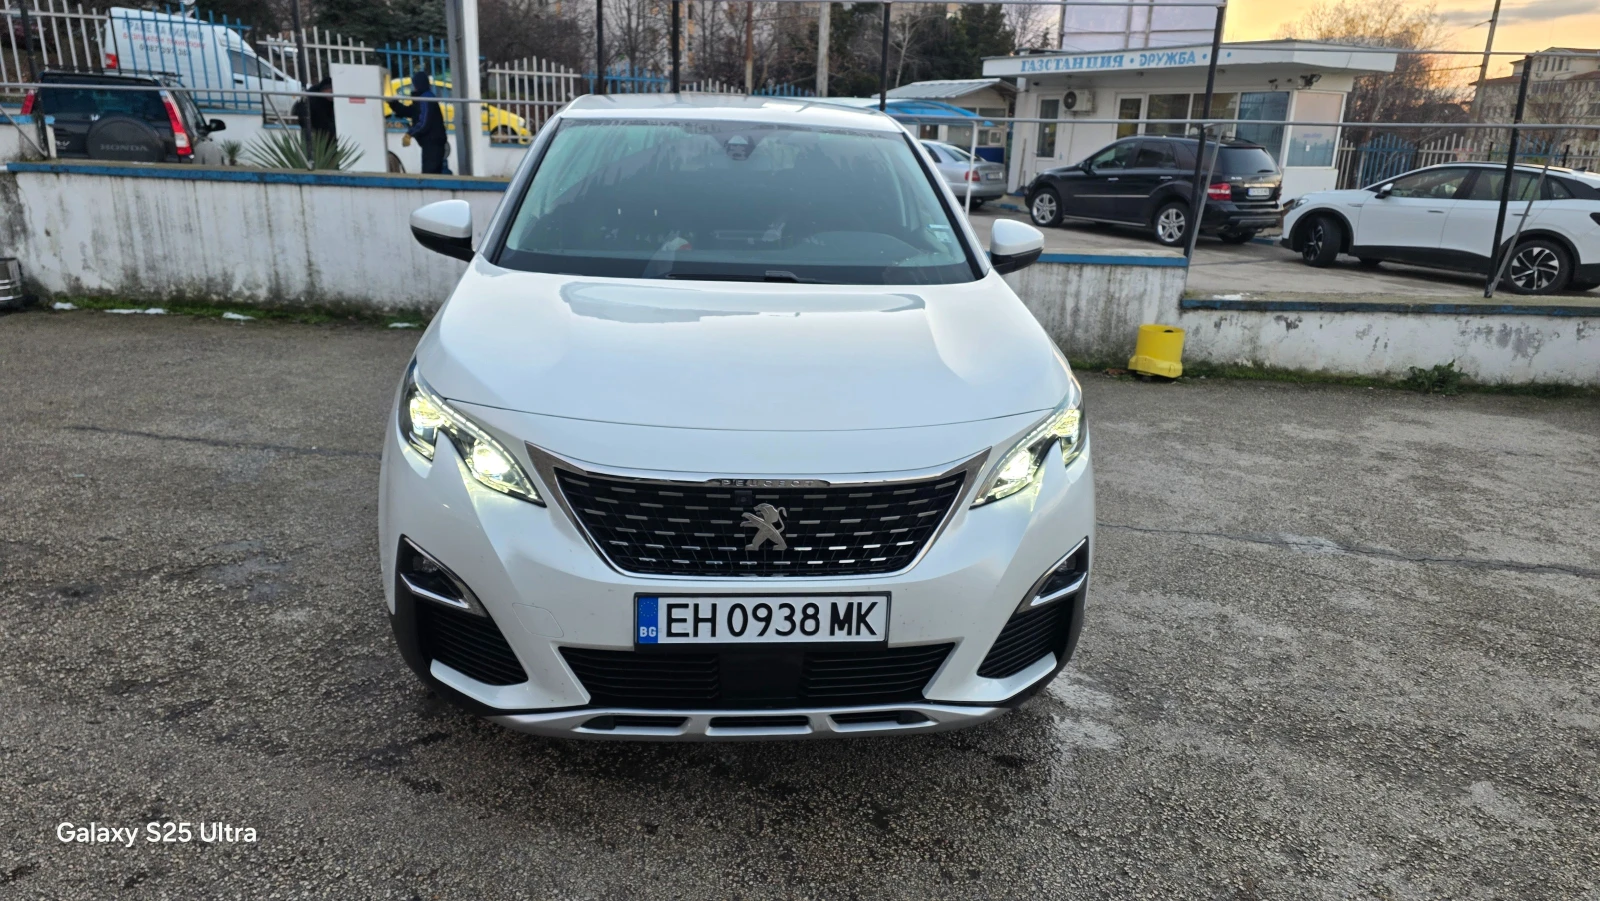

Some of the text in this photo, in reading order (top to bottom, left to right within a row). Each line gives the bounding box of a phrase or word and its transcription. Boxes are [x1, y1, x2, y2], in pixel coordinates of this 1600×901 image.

[1021, 54, 1125, 72] ГАЗСТАНЦИЯ
[100, 143, 149, 152] HONDA
[639, 601, 879, 638] BG EH 0938 MK
